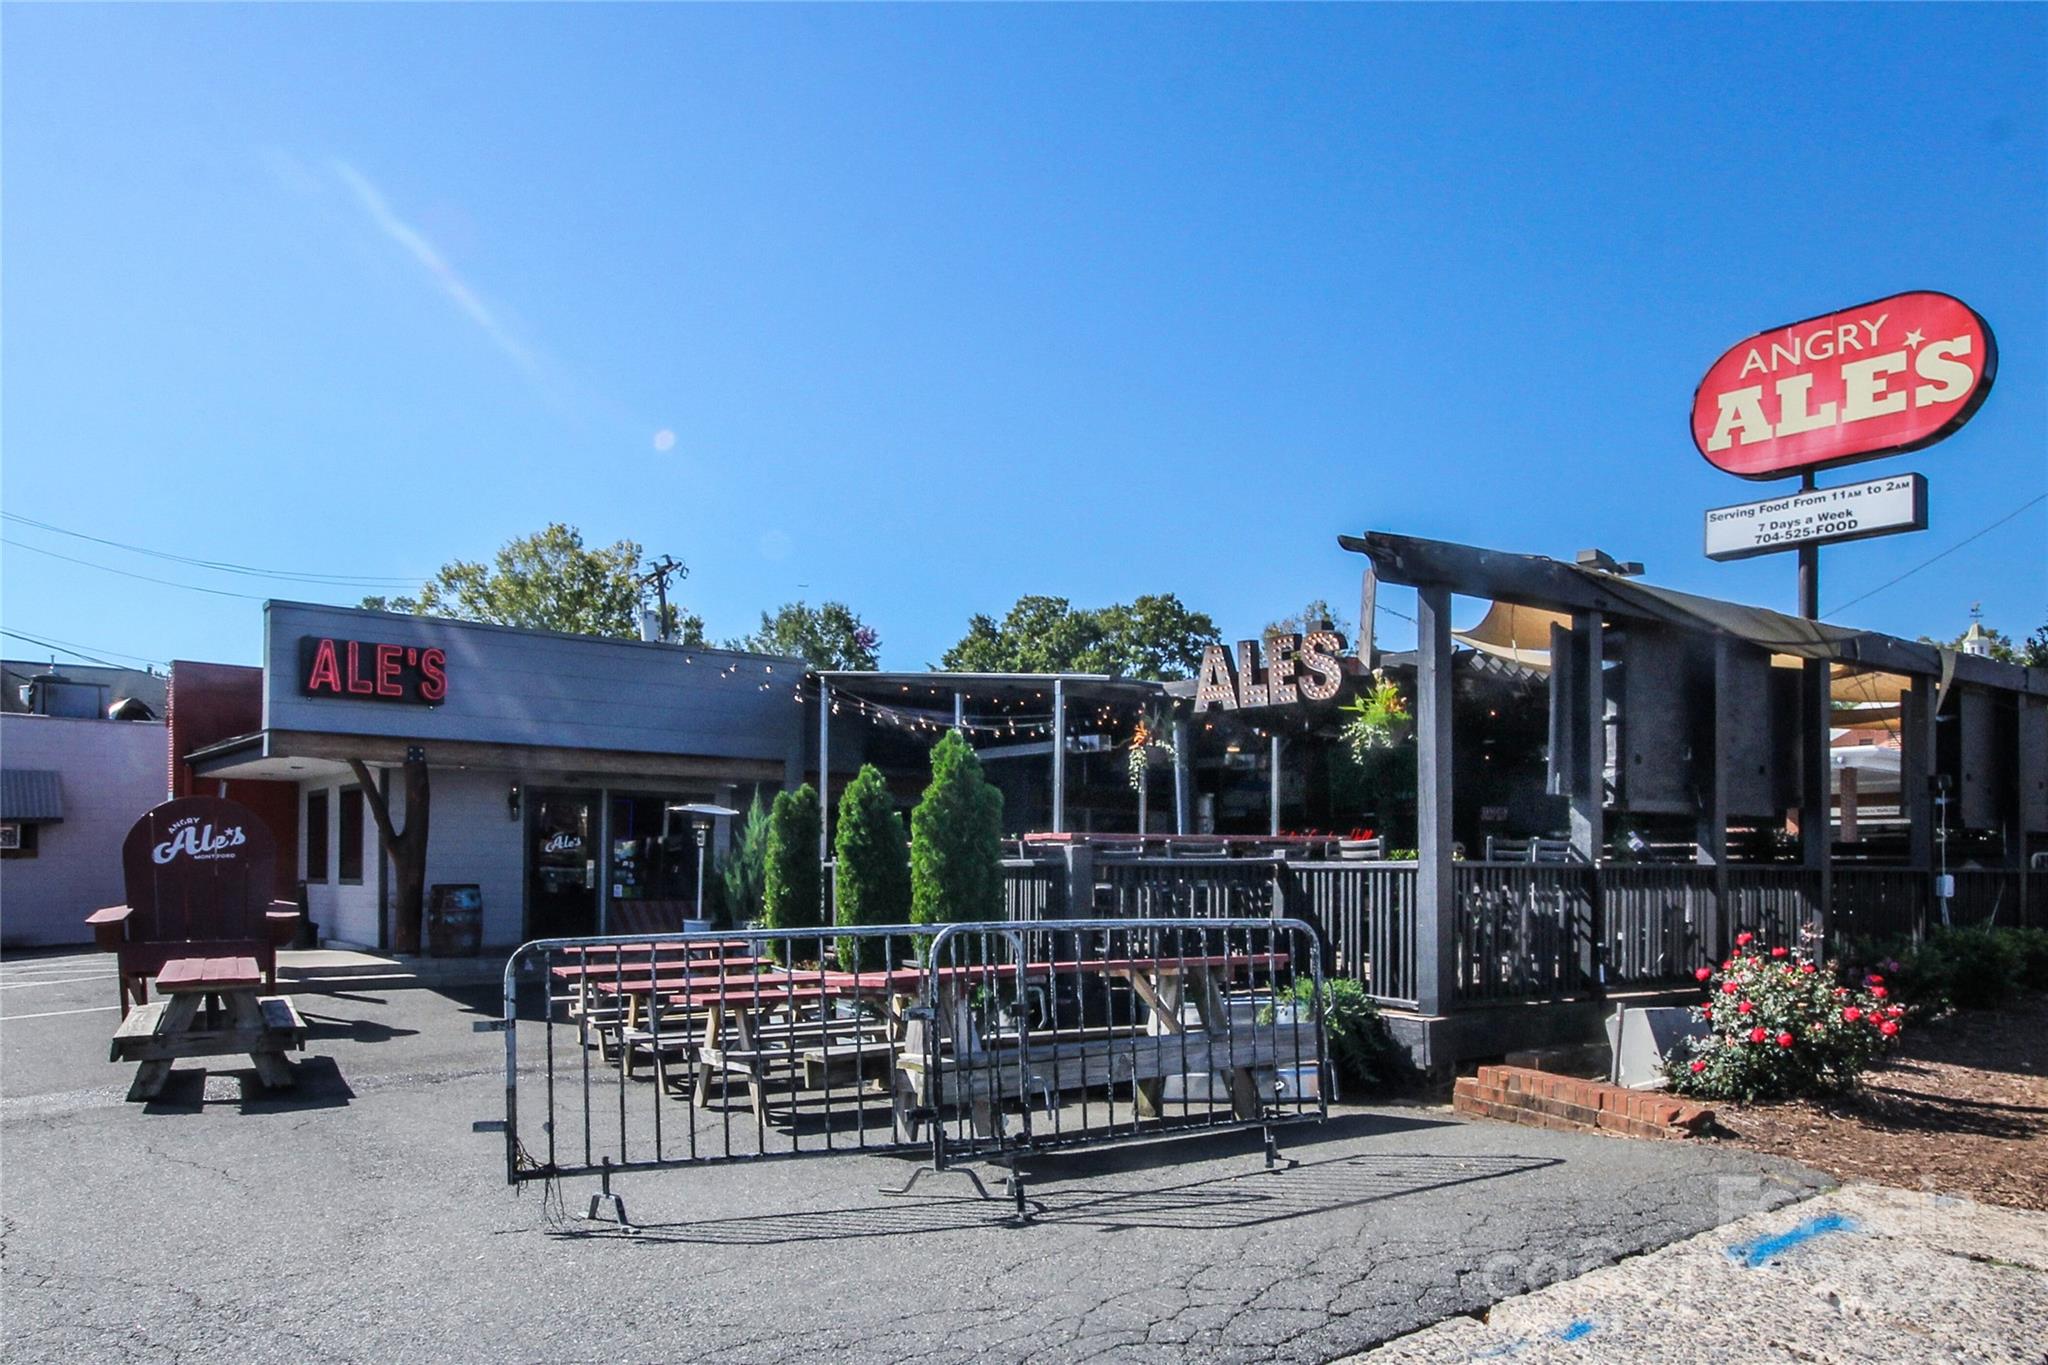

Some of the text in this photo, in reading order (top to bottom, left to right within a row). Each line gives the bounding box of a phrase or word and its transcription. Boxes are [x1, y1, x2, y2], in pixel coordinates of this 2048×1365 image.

[1739, 314, 1889, 379] ANGRY
[1709, 508, 1756, 522] Serving
[1759, 501, 1790, 514] Food
[1793, 495, 1827, 508] From
[1867, 484, 1882, 495] to
[1886, 481, 1910, 492] 2AM
[1758, 508, 1853, 532] 7 Days a Week
[1755, 519, 1859, 545] 704-525-FOOD
[308, 637, 448, 701] ALE'S
[1194, 630, 1347, 713] ALES
[168, 817, 200, 834] ANGRY
